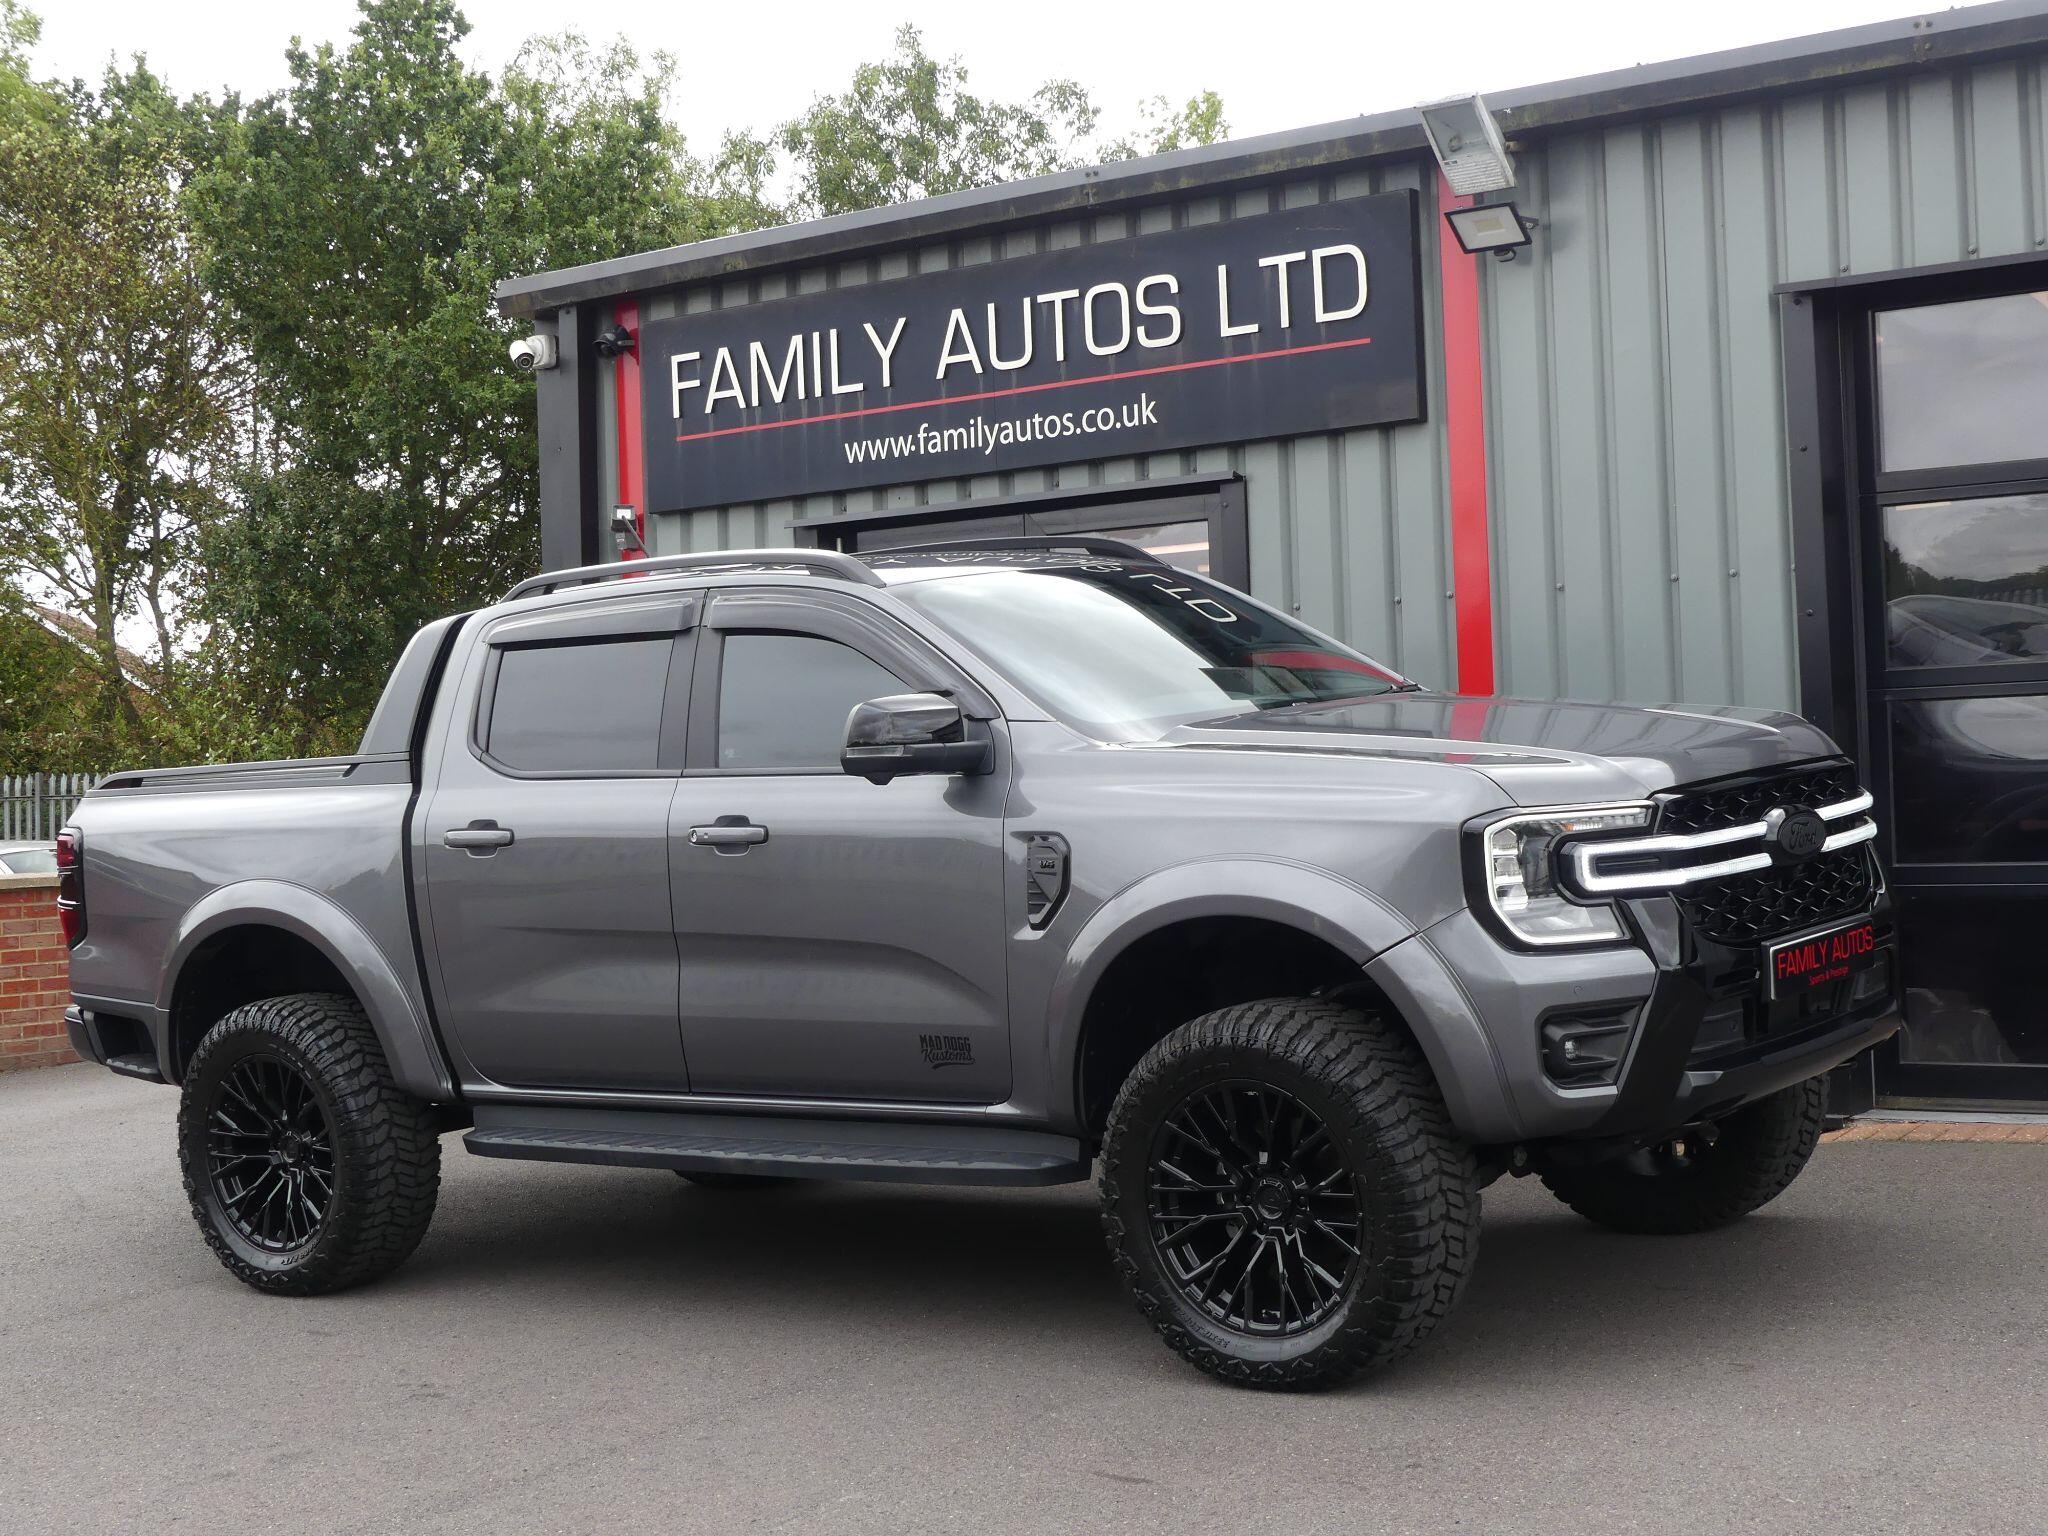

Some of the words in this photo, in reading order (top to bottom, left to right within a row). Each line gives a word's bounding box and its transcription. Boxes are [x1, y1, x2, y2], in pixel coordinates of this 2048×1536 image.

[670, 316, 907, 419] FAMILY
[935, 273, 1182, 380] AUTOS
[1217, 243, 1369, 338] LTD
[844, 392, 1158, 464] www.familyautos.co.uk
[1777, 940, 1828, 979] FAMILY
[1832, 925, 1873, 962] AUTOS
[920, 1034, 942, 1051] MAD
